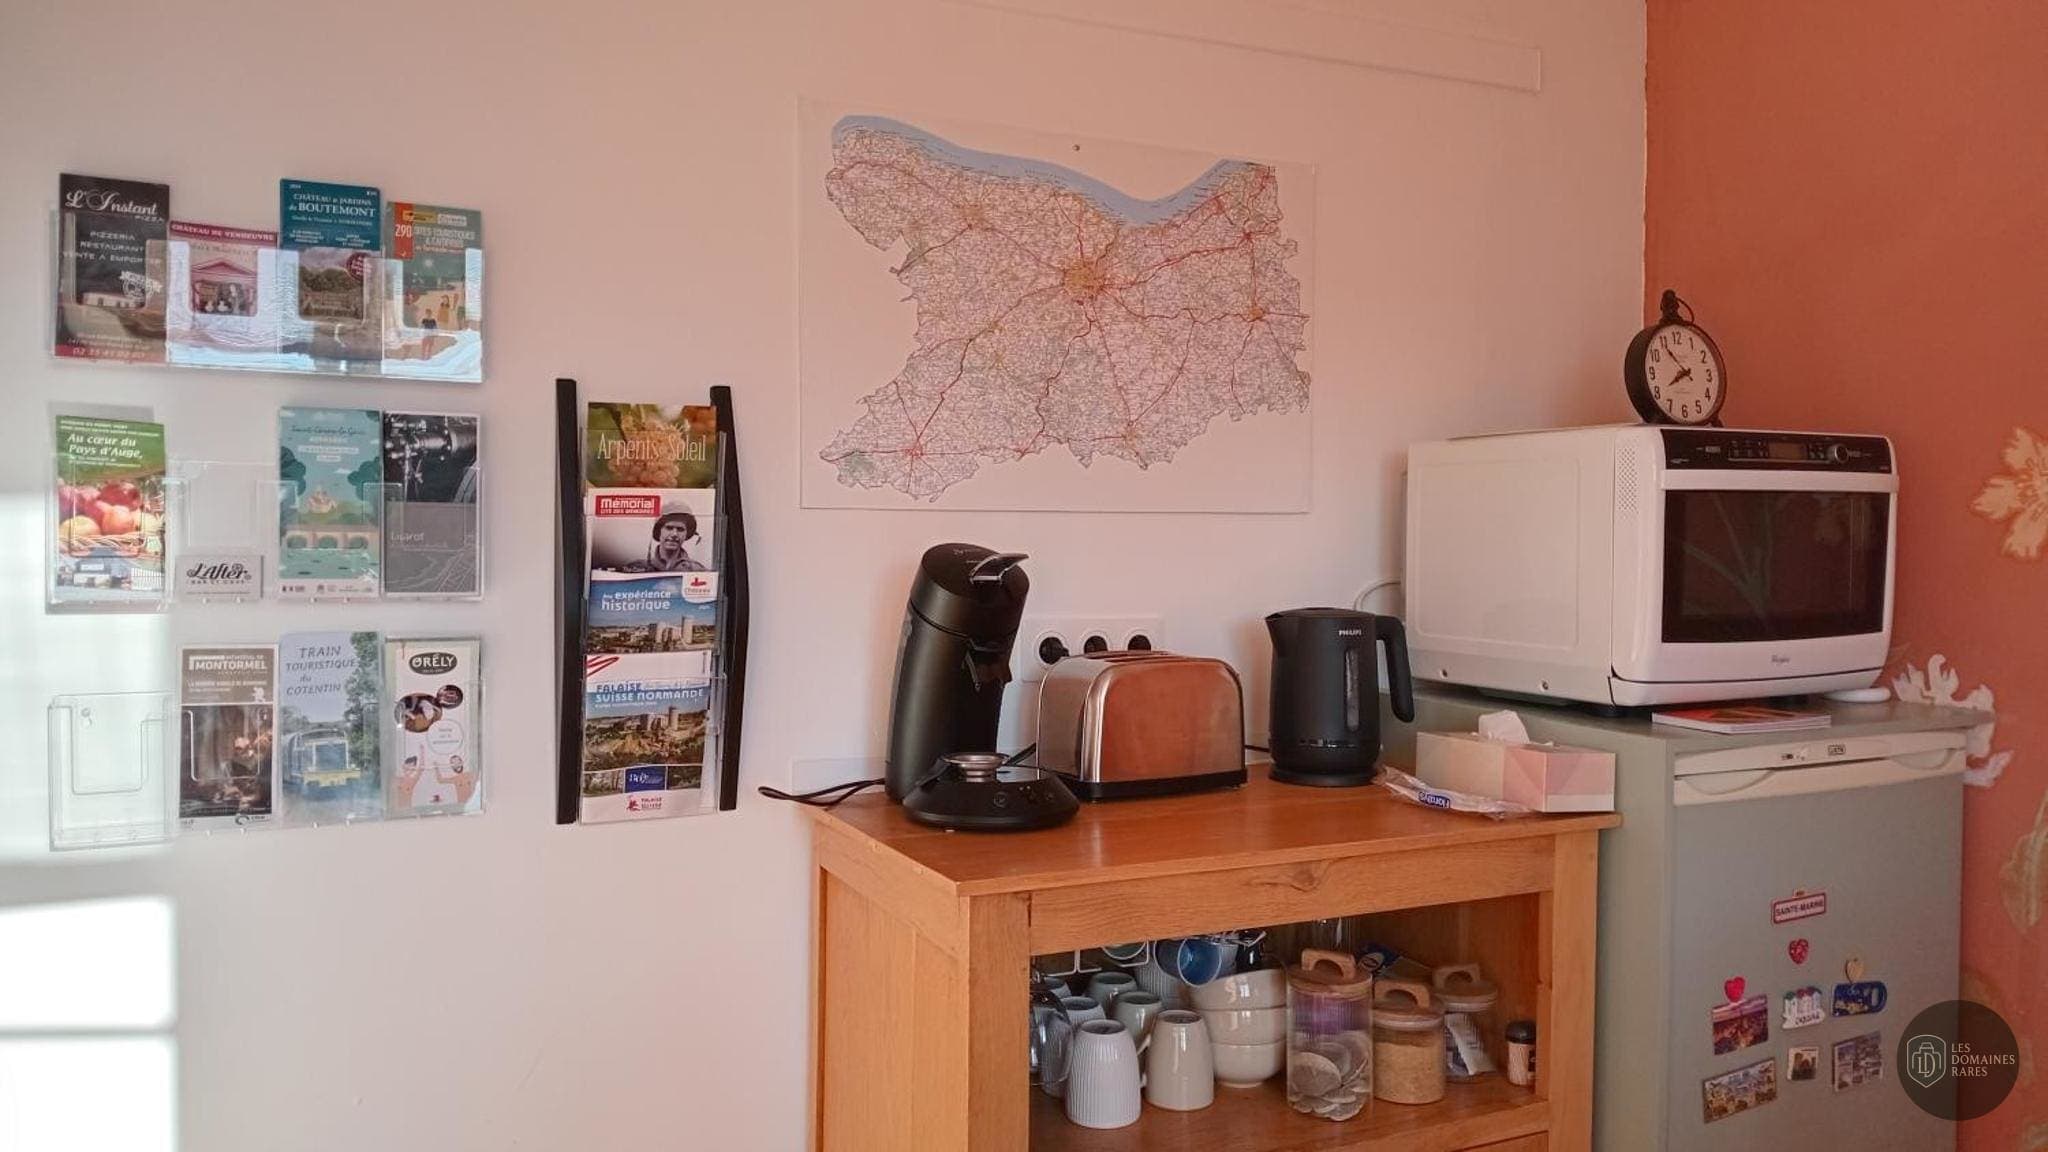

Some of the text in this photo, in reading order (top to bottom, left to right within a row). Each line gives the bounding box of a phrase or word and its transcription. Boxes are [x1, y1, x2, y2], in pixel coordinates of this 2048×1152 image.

[65, 189, 157, 215] L'Instant
[298, 202, 376, 217] BOUTEMONT
[395, 224, 412, 238] 290
[1660, 336, 1668, 349] 11
[1672, 331, 1682, 345] 12
[1689, 337, 1694, 350] 1
[1650, 348, 1660, 363] 10
[1700, 350, 1707, 364] 2
[1648, 366, 1656, 380] 9
[1705, 369, 1712, 382] 3
[1654, 386, 1661, 400] 8
[1704, 388, 1712, 402] 4
[1666, 399, 1673, 413] 7
[1681, 404, 1689, 419] 6
[1695, 400, 1702, 414] 5
[67, 433, 84, 444] Au
[121, 437, 136, 447] du
[69, 444, 97, 456] Pays
[597, 431, 706, 466] Arpents Soleil
[614, 588, 671, 601] expérience
[601, 599, 672, 613] historique
[299, 645, 342, 659] TRAIN
[195, 660, 269, 671] MONTORMEL
[285, 659, 356, 672] TOURISTIQUE
[286, 683, 342, 697] COTENTIN
[596, 691, 634, 703] SUISSE
